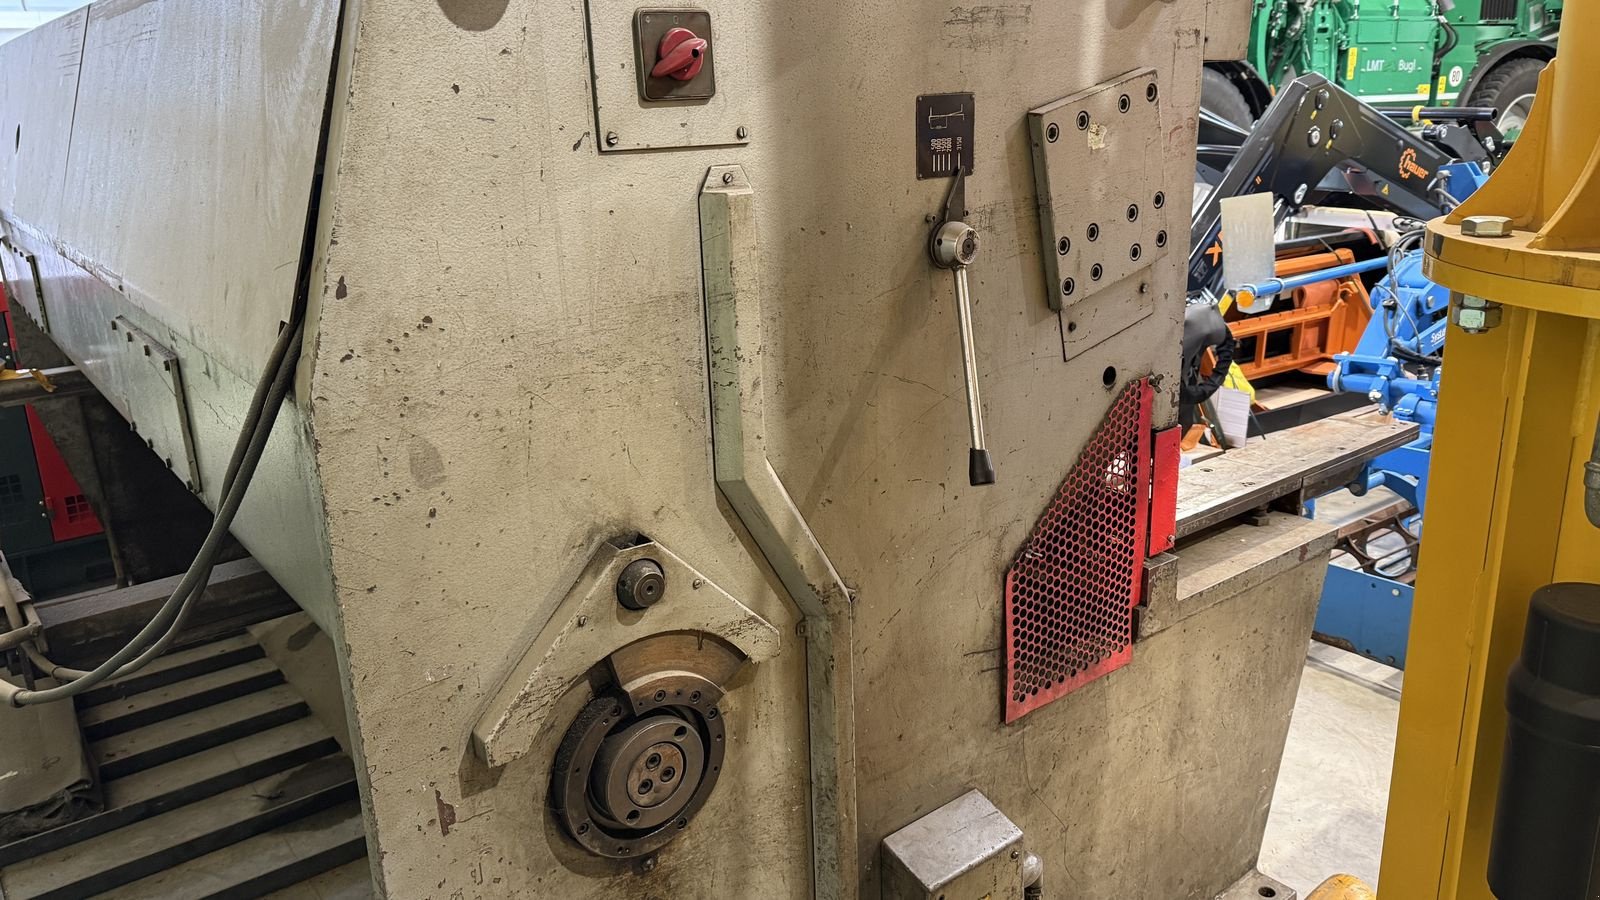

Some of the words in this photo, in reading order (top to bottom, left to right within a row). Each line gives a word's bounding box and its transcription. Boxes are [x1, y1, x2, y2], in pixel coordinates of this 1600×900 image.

[1366, 60, 1384, 72] LMT
[1451, 70, 1461, 82] 80
[1403, 154, 1429, 179] hauer
